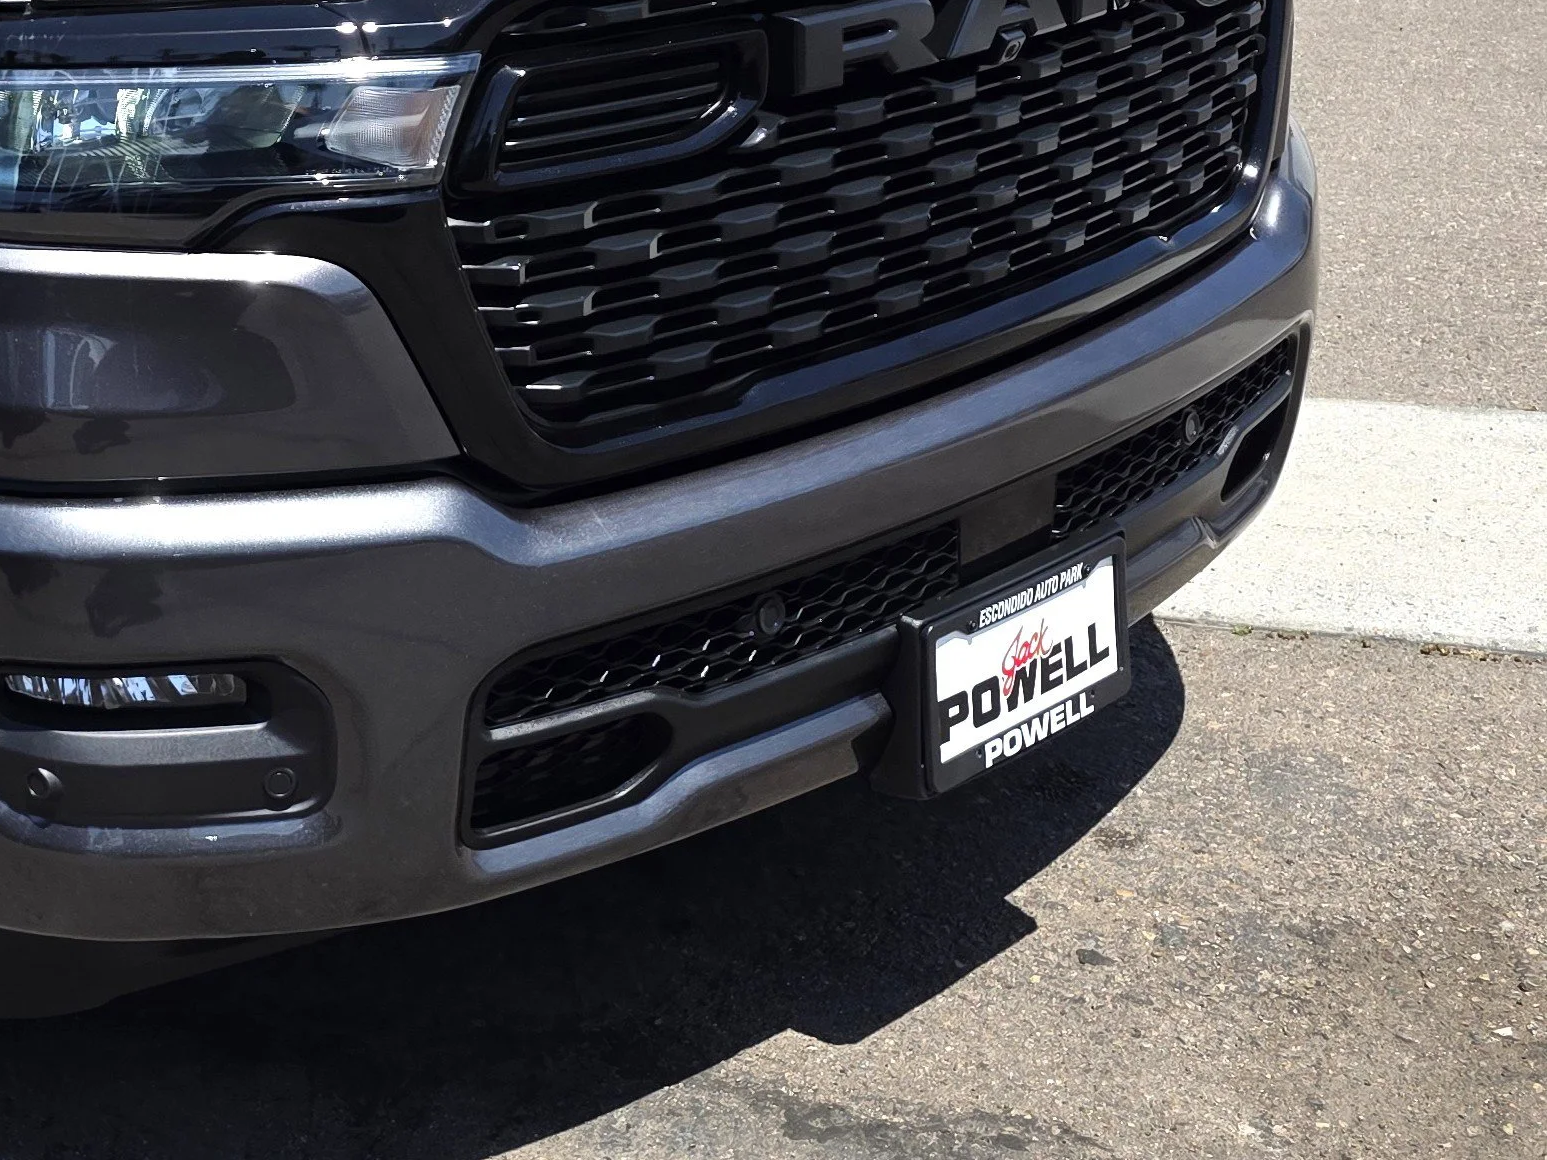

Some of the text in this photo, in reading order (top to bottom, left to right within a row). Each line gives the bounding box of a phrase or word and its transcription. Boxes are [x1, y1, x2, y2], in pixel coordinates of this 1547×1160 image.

[978, 562, 1085, 628] ESCONDIDO AUTO PARK
[938, 622, 1110, 745] POWELL
[1001, 618, 1054, 697] Jack
[984, 691, 1095, 769] POWELL
